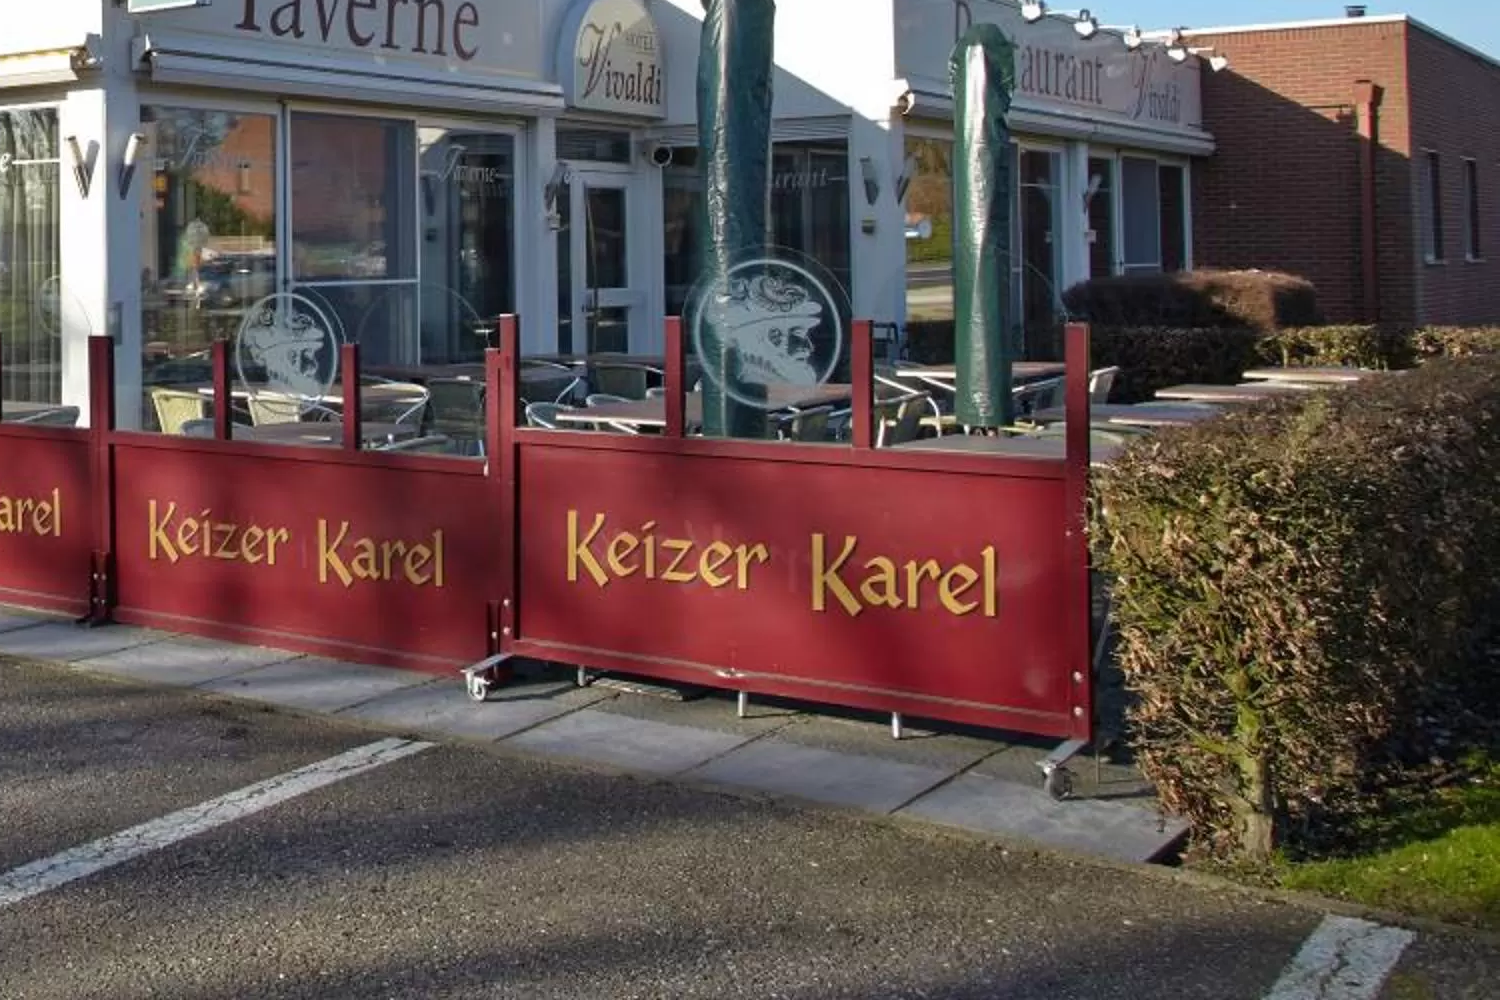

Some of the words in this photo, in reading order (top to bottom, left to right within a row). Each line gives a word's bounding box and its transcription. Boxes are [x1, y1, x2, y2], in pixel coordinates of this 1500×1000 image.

[579, 21, 661, 105] Vivaldi
[148, 500, 290, 565] Keizer
[317, 519, 443, 588] Karel
[567, 509, 770, 590] Keizer
[810, 532, 997, 617] Karel
